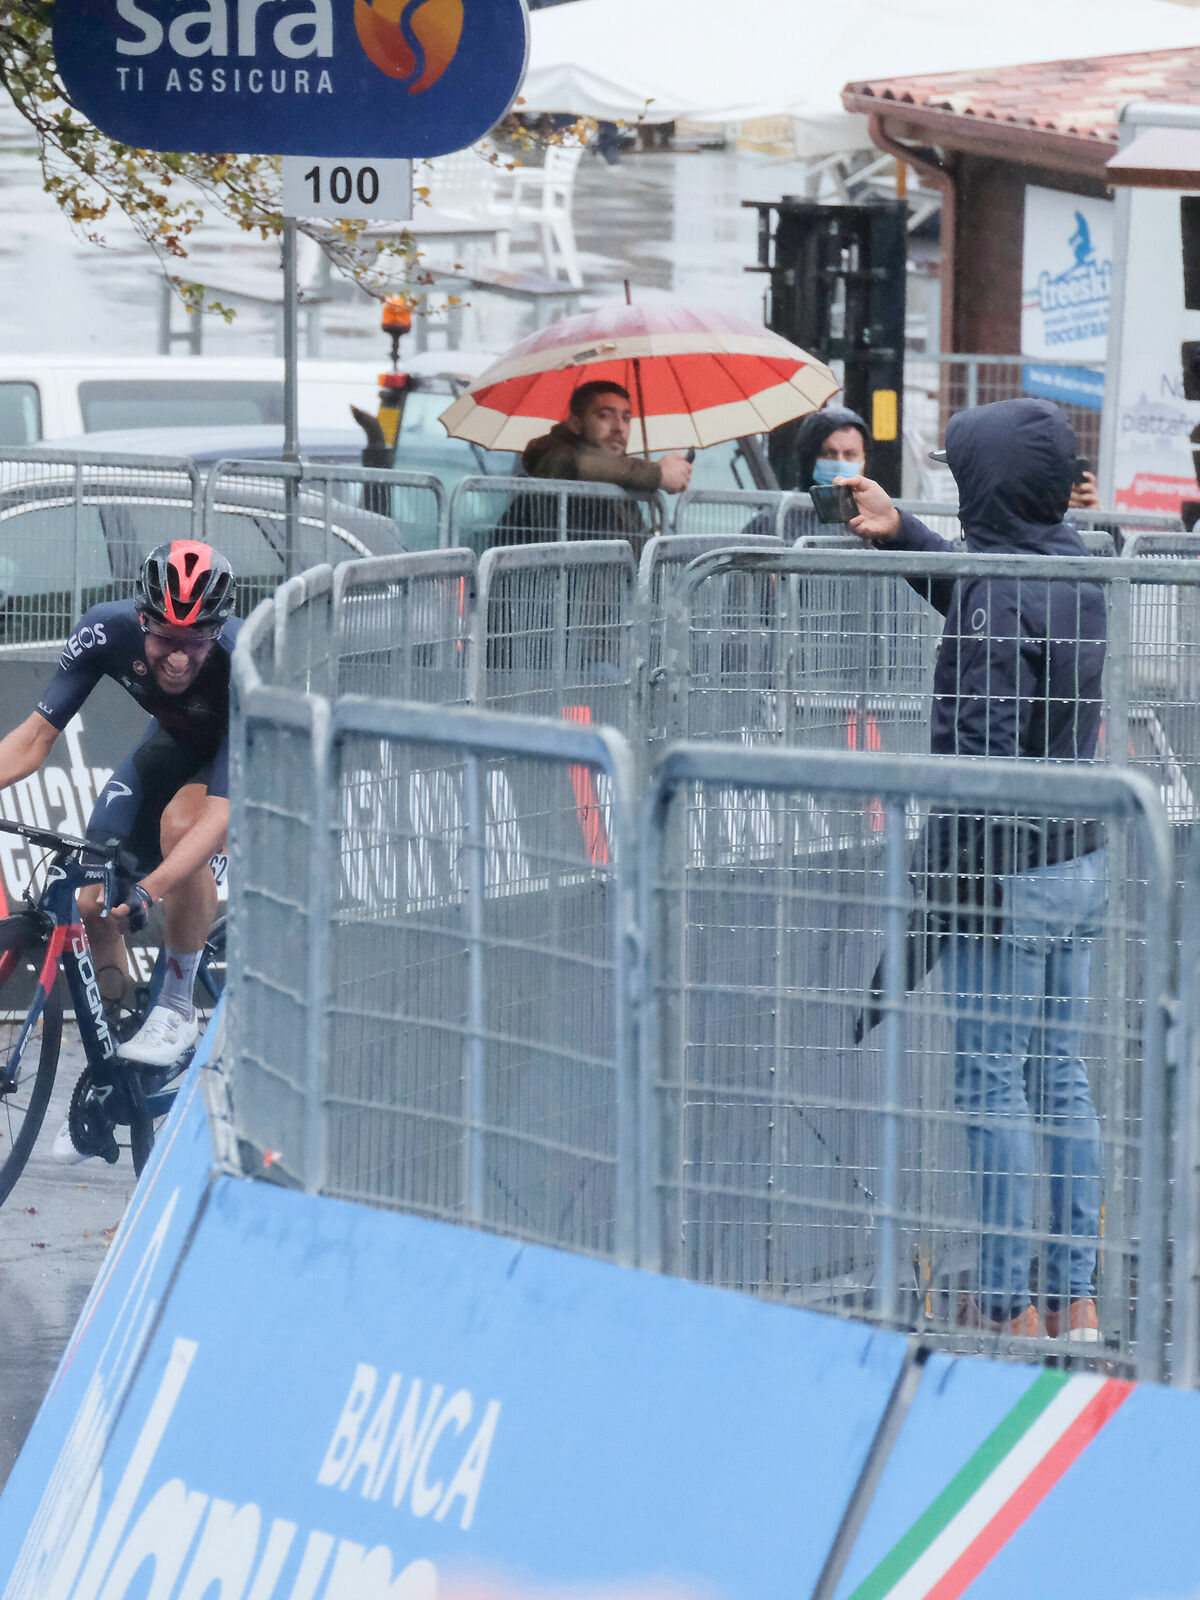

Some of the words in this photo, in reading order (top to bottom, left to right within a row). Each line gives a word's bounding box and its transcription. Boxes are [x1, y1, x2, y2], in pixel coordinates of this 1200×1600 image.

[116, 67, 144, 92] TI
[166, 68, 334, 95] ASSICURA
[303, 166, 380, 204] 100
[316, 1362, 501, 1531] BANCA
